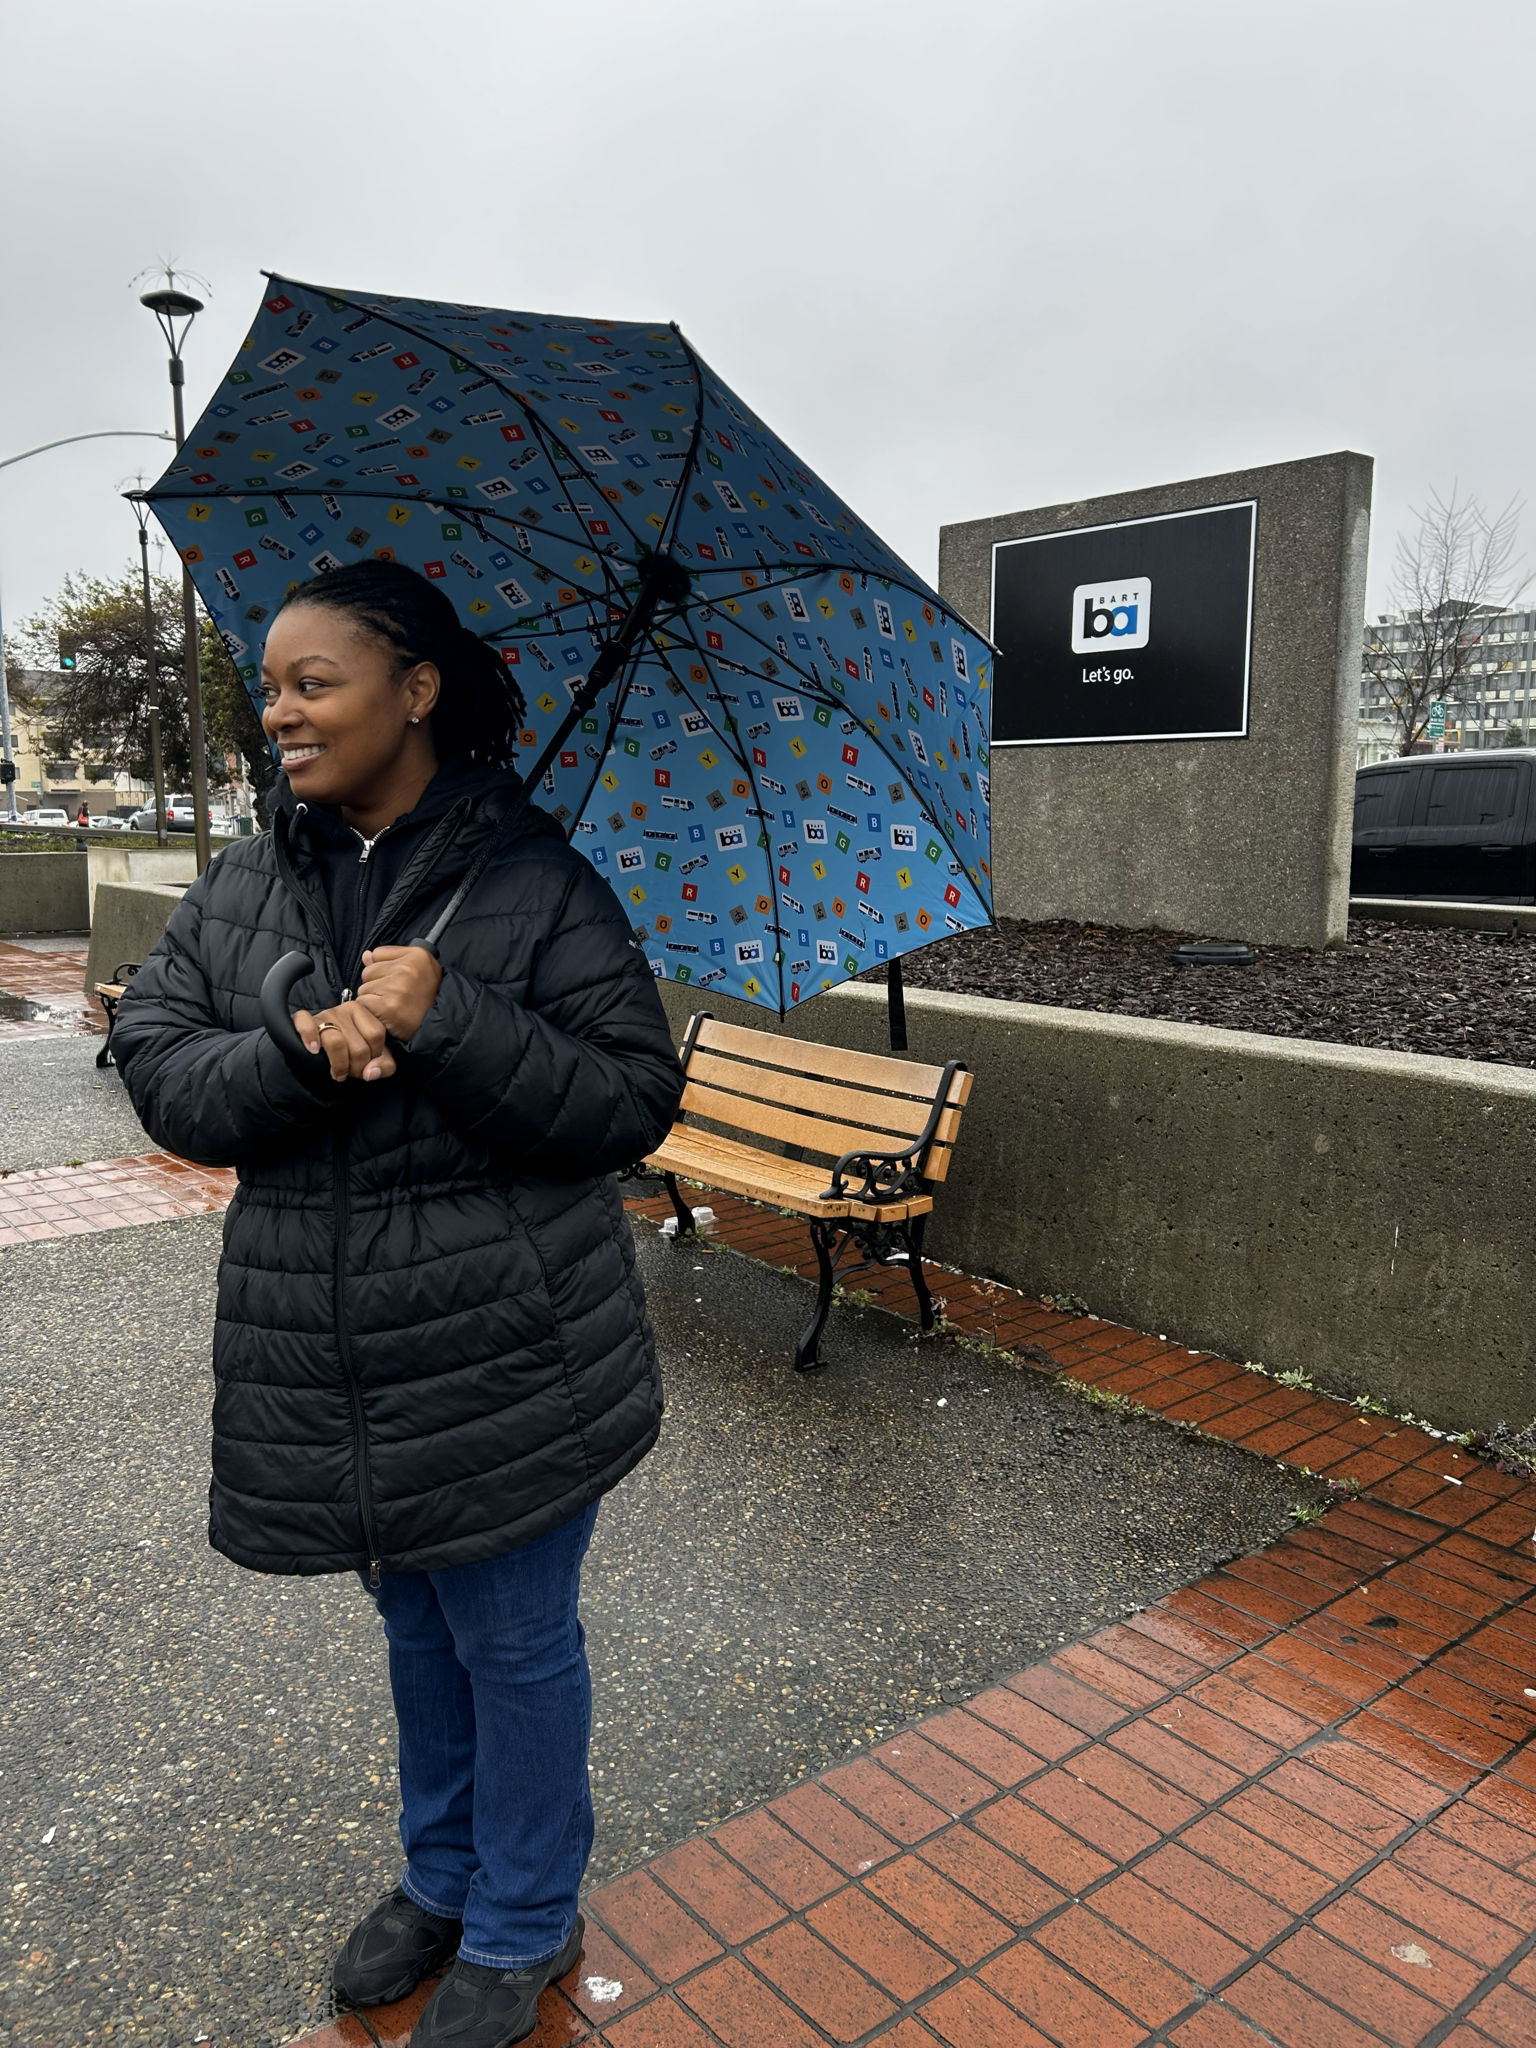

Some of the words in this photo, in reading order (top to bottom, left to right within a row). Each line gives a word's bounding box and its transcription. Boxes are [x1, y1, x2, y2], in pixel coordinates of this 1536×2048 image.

[508, 429, 518, 437] R
[721, 437, 729, 446] R
[710, 455, 718, 464] G
[764, 480, 773, 488] O
[608, 491, 617, 499] O
[196, 508, 205, 517] Y
[396, 509, 405, 519] Y
[252, 513, 262, 522] G
[306, 530, 316, 539] B
[186, 551, 197, 560] O
[240, 556, 250, 564] R
[380, 552, 390, 561] O
[582, 561, 591, 569] Y
[745, 577, 754, 586] O
[1100, 593, 1138, 604] BART
[1083, 598, 1138, 639] ba
[712, 636, 718, 645] R
[694, 670, 703, 679] O
[1082, 666, 1110, 683] Let's
[1114, 668, 1134, 684] go.
[834, 682, 842, 690] G
[544, 698, 552, 707] Y
[752, 695, 759, 704] B
[703, 754, 711, 763] Y
[737, 784, 745, 794] O
[635, 807, 643, 816] O
[693, 829, 700, 838] B
[596, 851, 602, 860] B
[732, 869, 739, 878] Y
[687, 888, 692, 897] R
[949, 891, 955, 901] R
[760, 900, 768, 910] O
[714, 943, 720, 951] B
